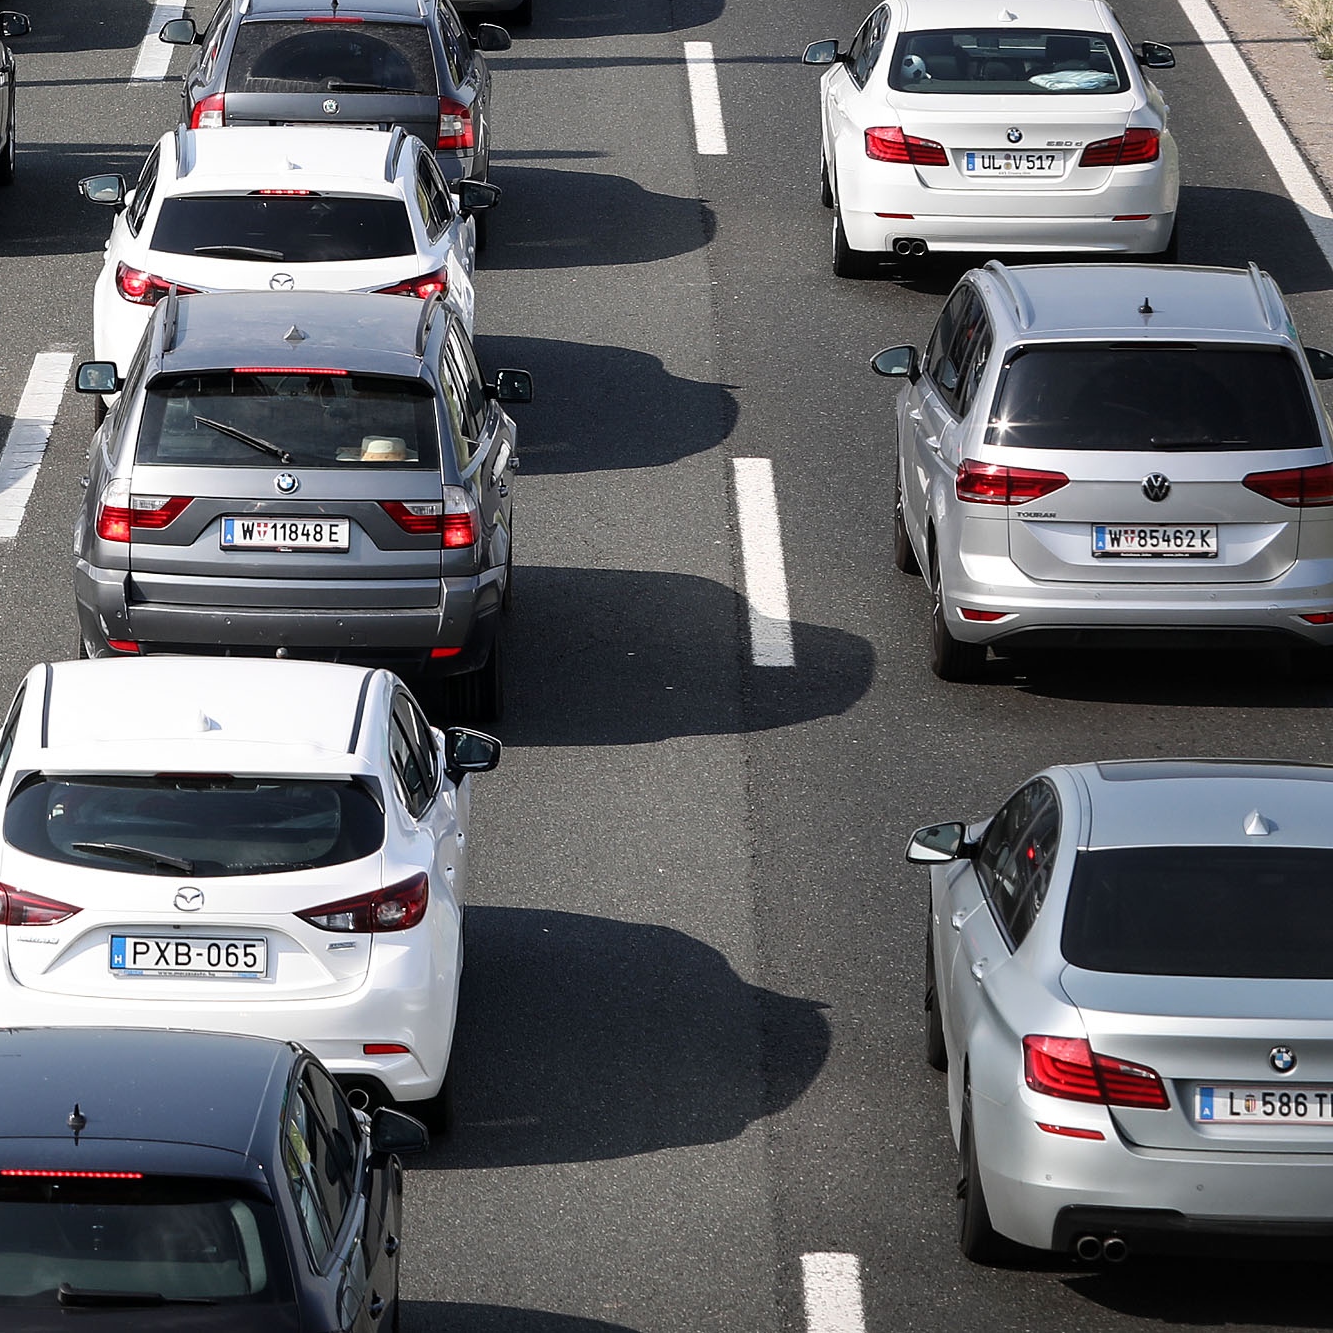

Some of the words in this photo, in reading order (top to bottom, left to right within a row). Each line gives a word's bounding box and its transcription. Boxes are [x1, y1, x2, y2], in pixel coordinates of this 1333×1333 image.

[981, 154, 1002, 170] UL
[1013, 154, 1023, 170] V
[1026, 154, 1055, 170] 517
[241, 522, 254, 541] W
[269, 522, 324, 542] 11848
[329, 523, 340, 542] E
[1109, 528, 1122, 548] W
[1137, 528, 1195, 548] 85462
[1201, 528, 1212, 548] K
[132, 943, 258, 968] PXB-065
[1228, 1092, 1241, 1116] L
[1261, 1092, 1308, 1117] 586
[1315, 1092, 1333, 1117] T
